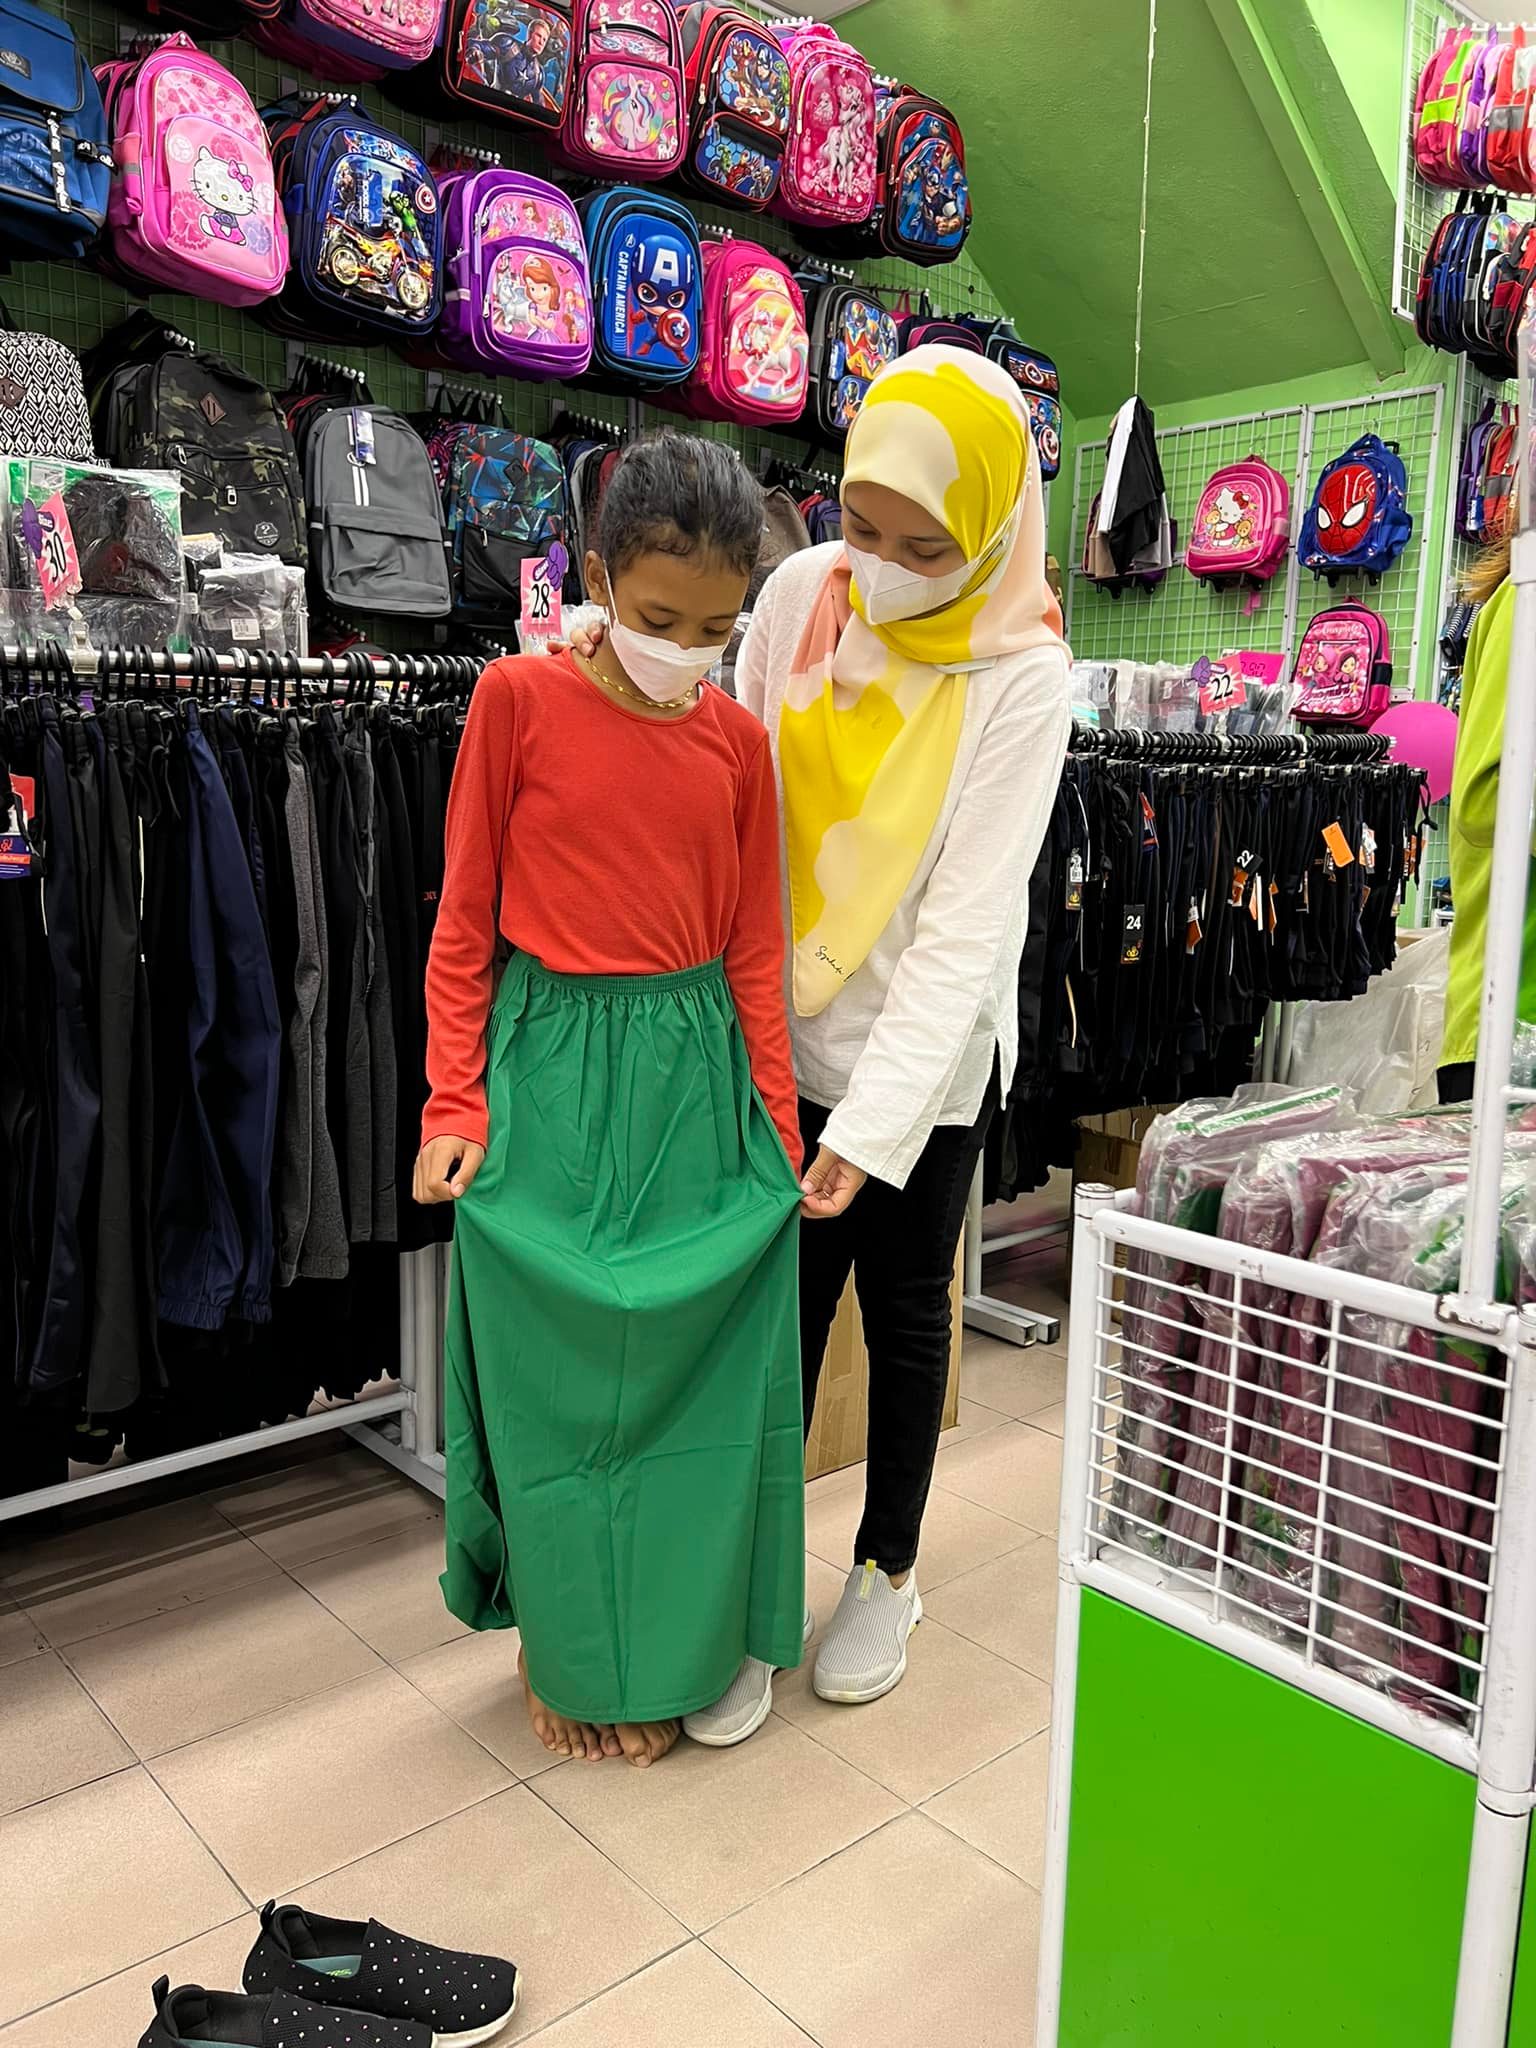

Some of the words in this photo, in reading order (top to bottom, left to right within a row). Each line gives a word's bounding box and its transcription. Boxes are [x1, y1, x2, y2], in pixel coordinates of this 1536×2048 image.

[616, 251, 629, 291] CAPTAIN
[615, 292, 627, 333] AMERICA
[45, 531, 67, 583] 30
[531, 583, 550, 618] 28
[1211, 674, 1233, 701] 22
[1236, 849, 1254, 868] 22
[1126, 915, 1142, 930] 24
